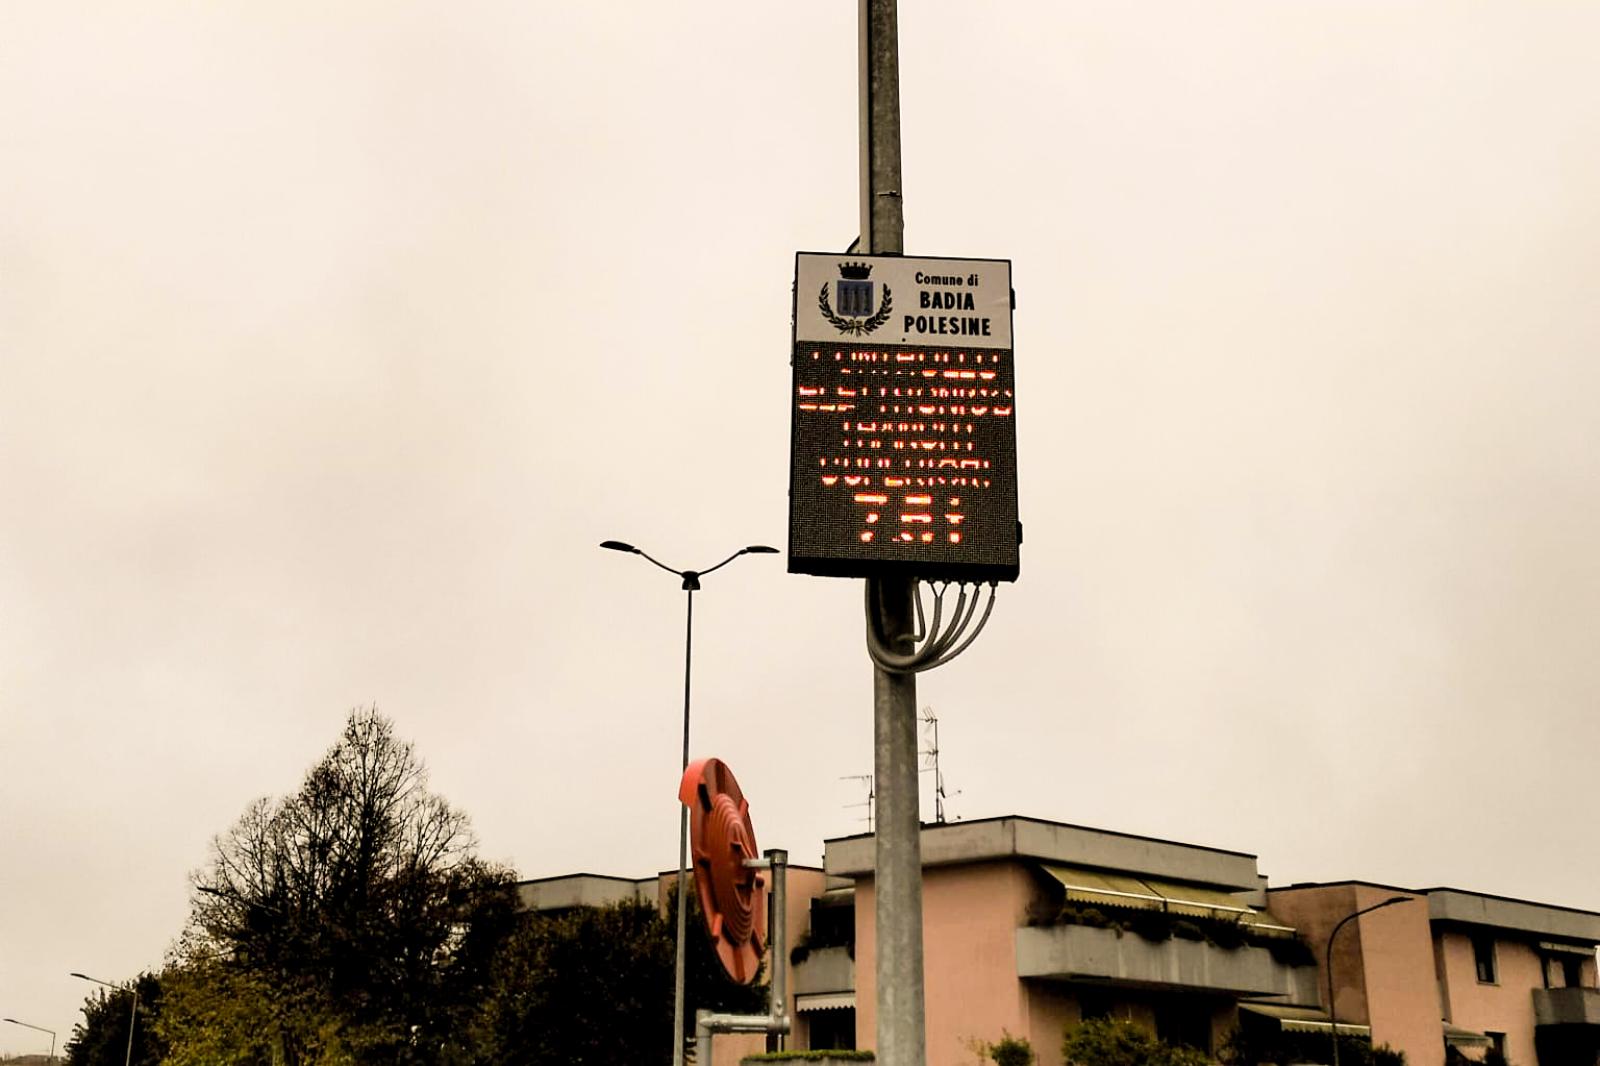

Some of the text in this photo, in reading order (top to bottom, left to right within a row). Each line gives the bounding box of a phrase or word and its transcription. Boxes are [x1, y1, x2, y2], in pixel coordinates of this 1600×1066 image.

[915, 271, 979, 287] Comune di
[919, 291, 975, 311] BADIA
[903, 315, 991, 336] POLESINE
